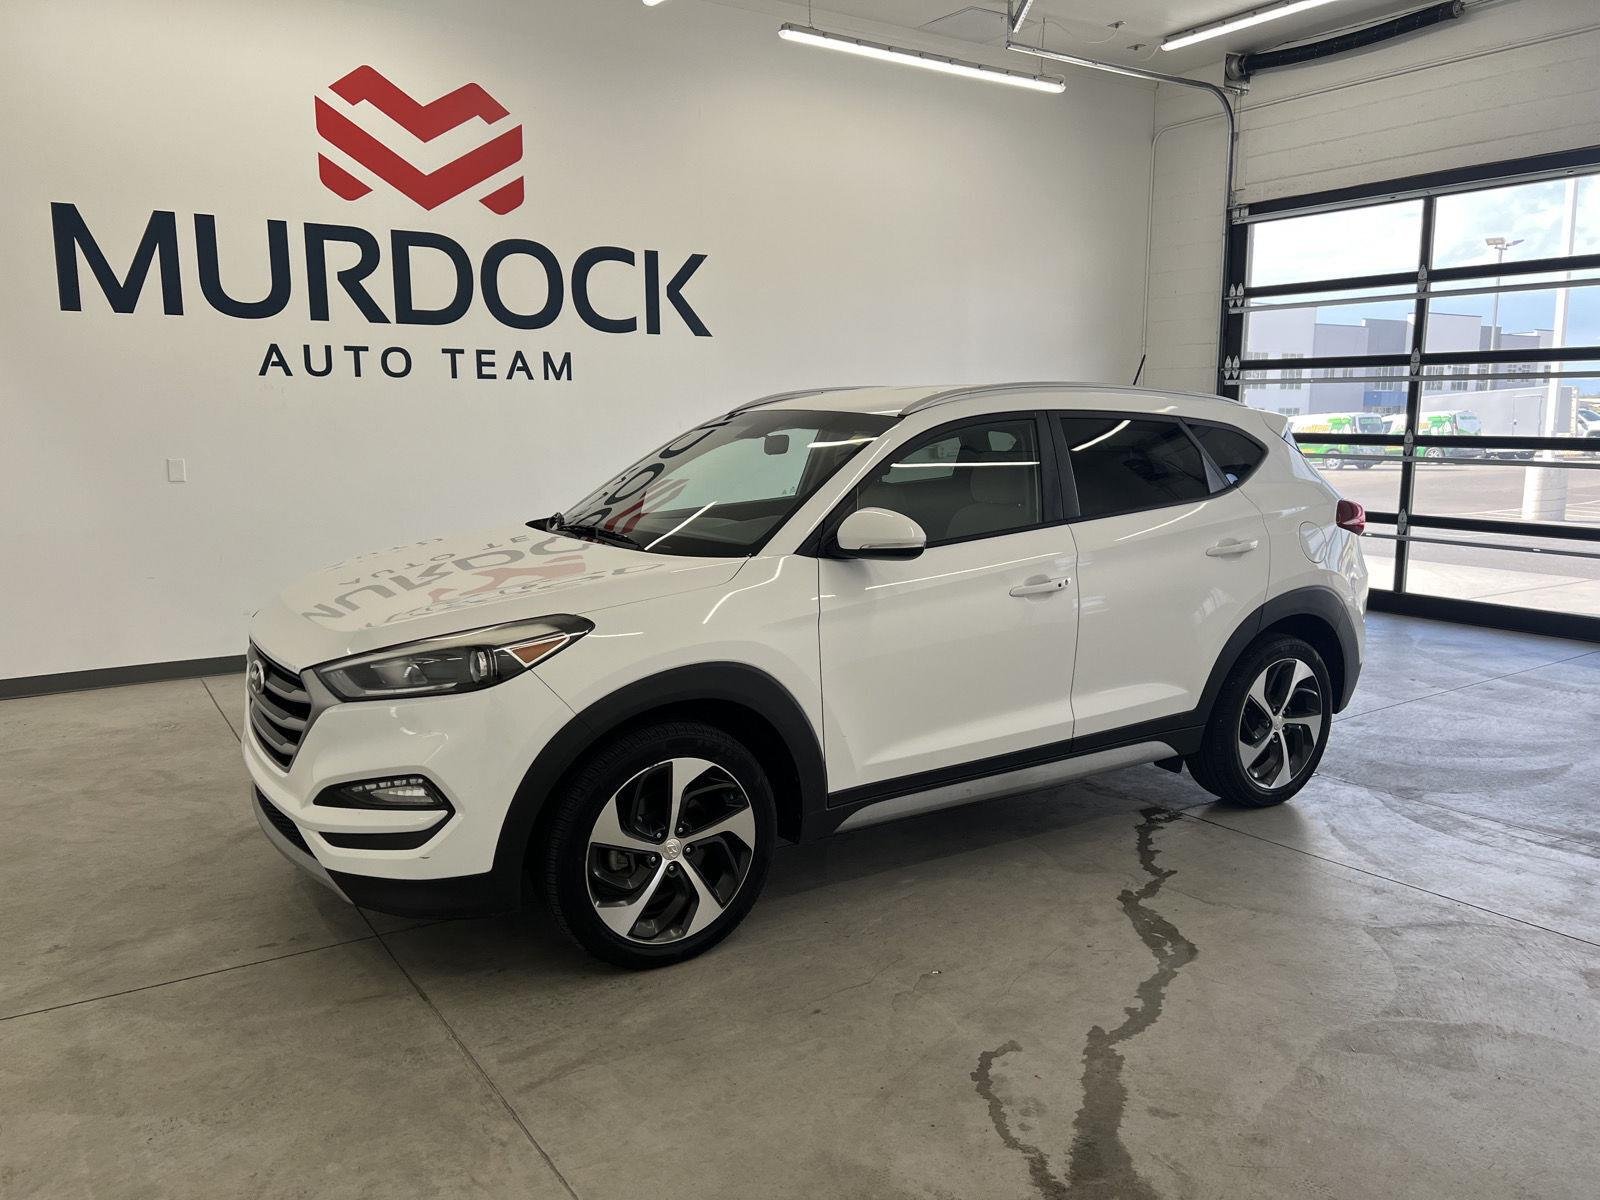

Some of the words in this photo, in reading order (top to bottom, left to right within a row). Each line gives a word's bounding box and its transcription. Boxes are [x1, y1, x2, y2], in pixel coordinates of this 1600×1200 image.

[51, 202, 713, 337] MURDOCK
[259, 344, 412, 379] AUTO
[442, 349, 573, 381] TEAM
